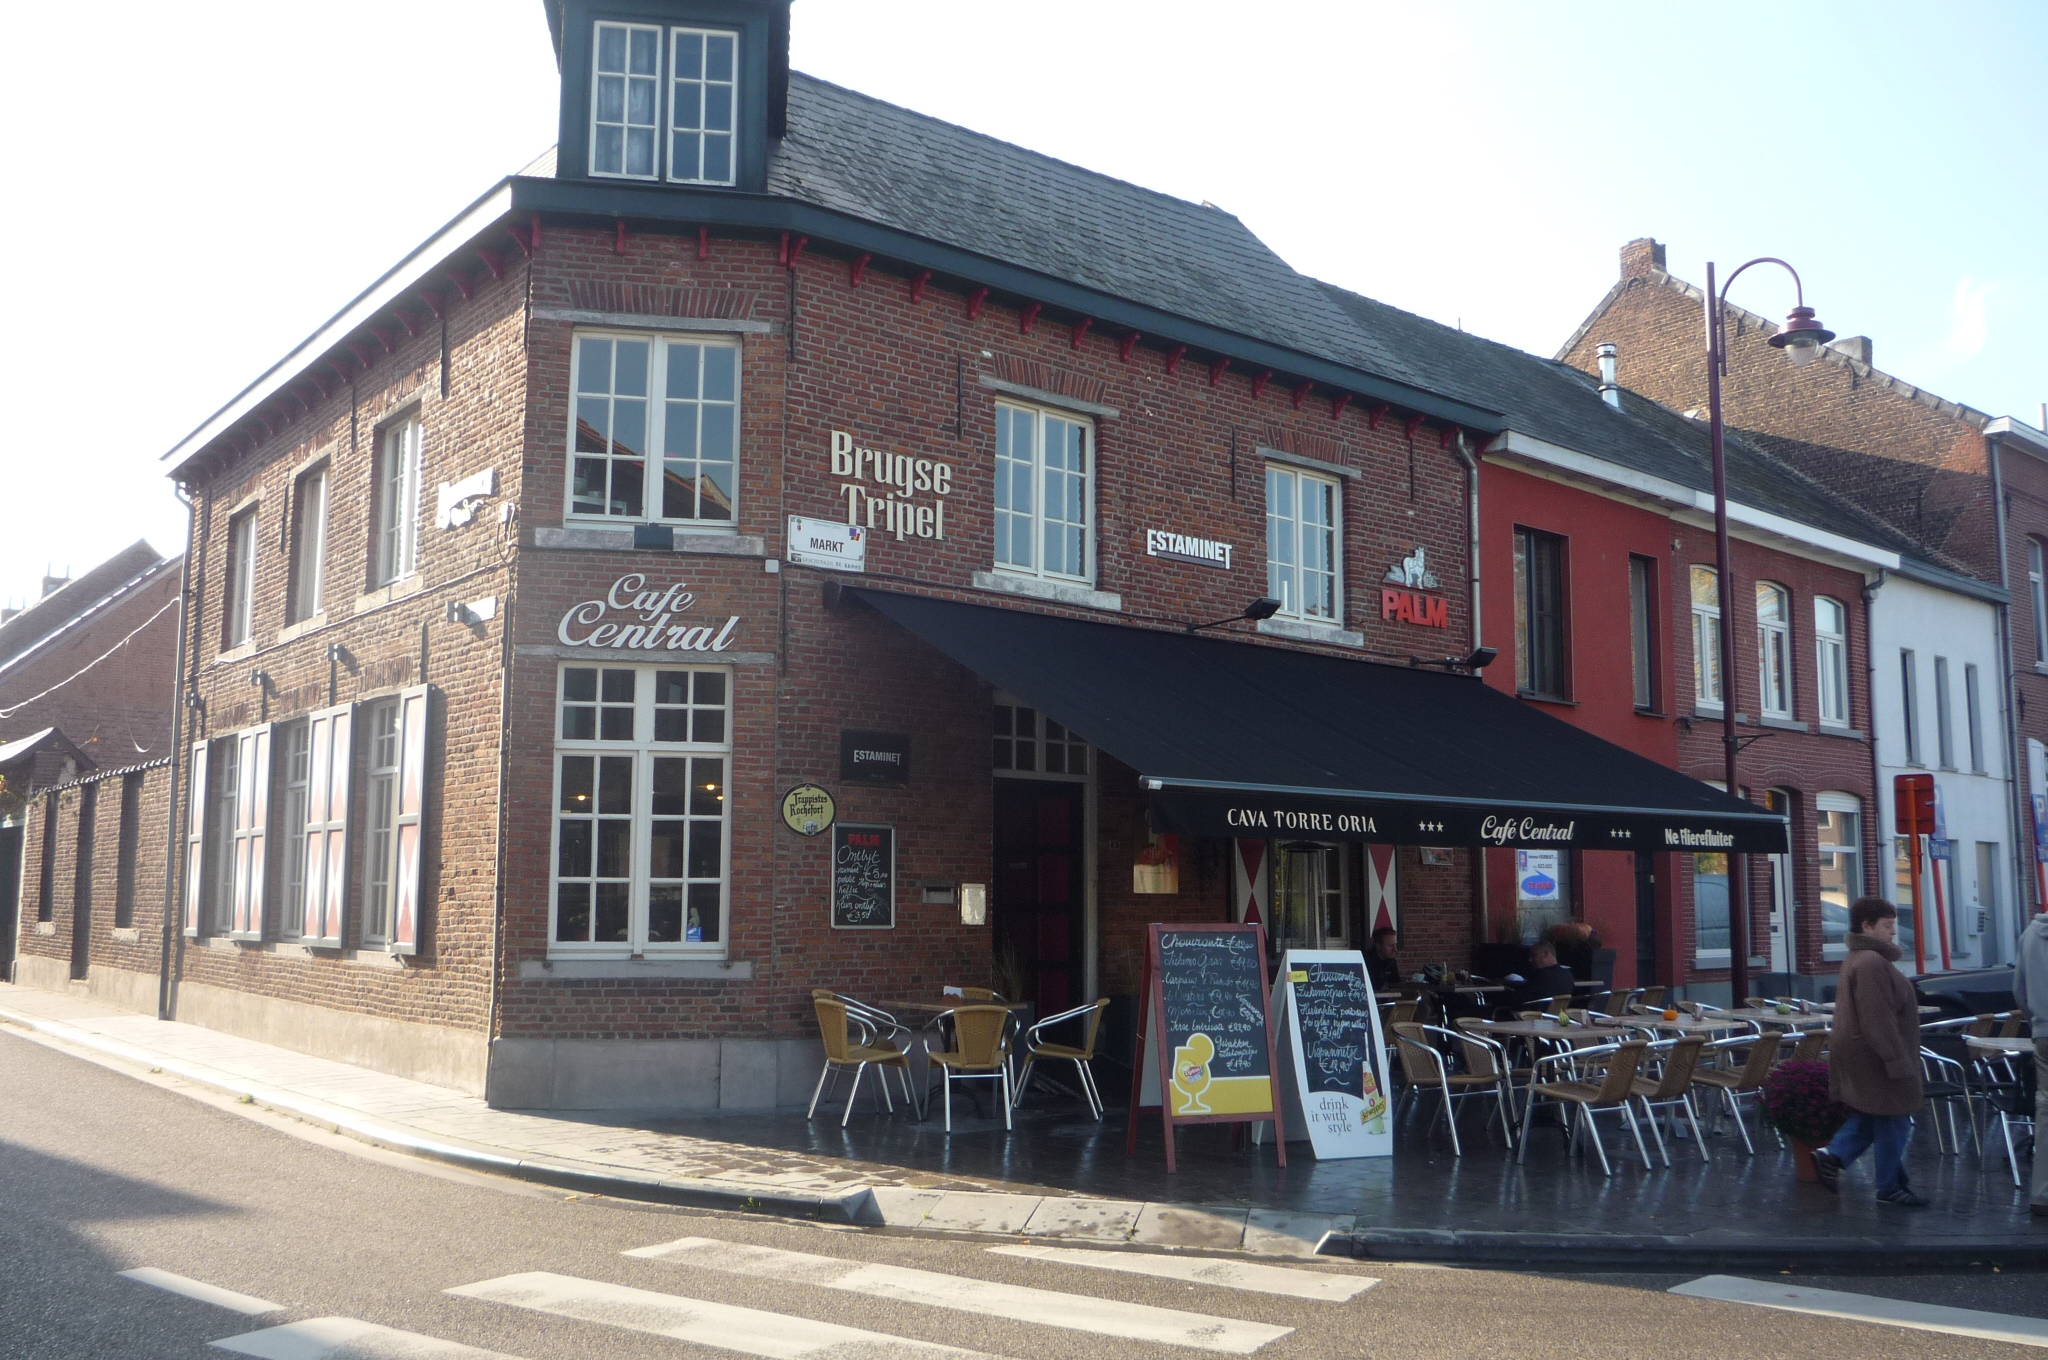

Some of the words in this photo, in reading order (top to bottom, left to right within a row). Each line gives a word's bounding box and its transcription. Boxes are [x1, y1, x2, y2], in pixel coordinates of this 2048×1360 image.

[830, 430, 951, 498] Brugse
[840, 483, 944, 541] Tripel
[810, 537, 844, 553] MARKT
[1147, 529, 1232, 569] ESTAMINET
[607, 573, 696, 621] Cafe
[1382, 588, 1448, 629] PALM
[558, 600, 740, 652] Central
[853, 749, 901, 766] ESTAMINET
[789, 804, 824, 817] Rochefort
[792, 792, 828, 807] Trappistes
[1227, 808, 1268, 828] CAVA
[1273, 810, 1334, 831] TORRE
[1338, 814, 1377, 833] ORIA
[1480, 815, 1517, 846] Café
[1519, 816, 1575, 841] Central
[1664, 828, 1679, 845] Ne
[1680, 828, 1734, 847] Flierefluiter
[1320, 1096, 1349, 1110] drink
[1311, 1110, 1319, 1122] it
[1322, 1107, 1347, 1121] with
[1328, 1120, 1352, 1136] style
